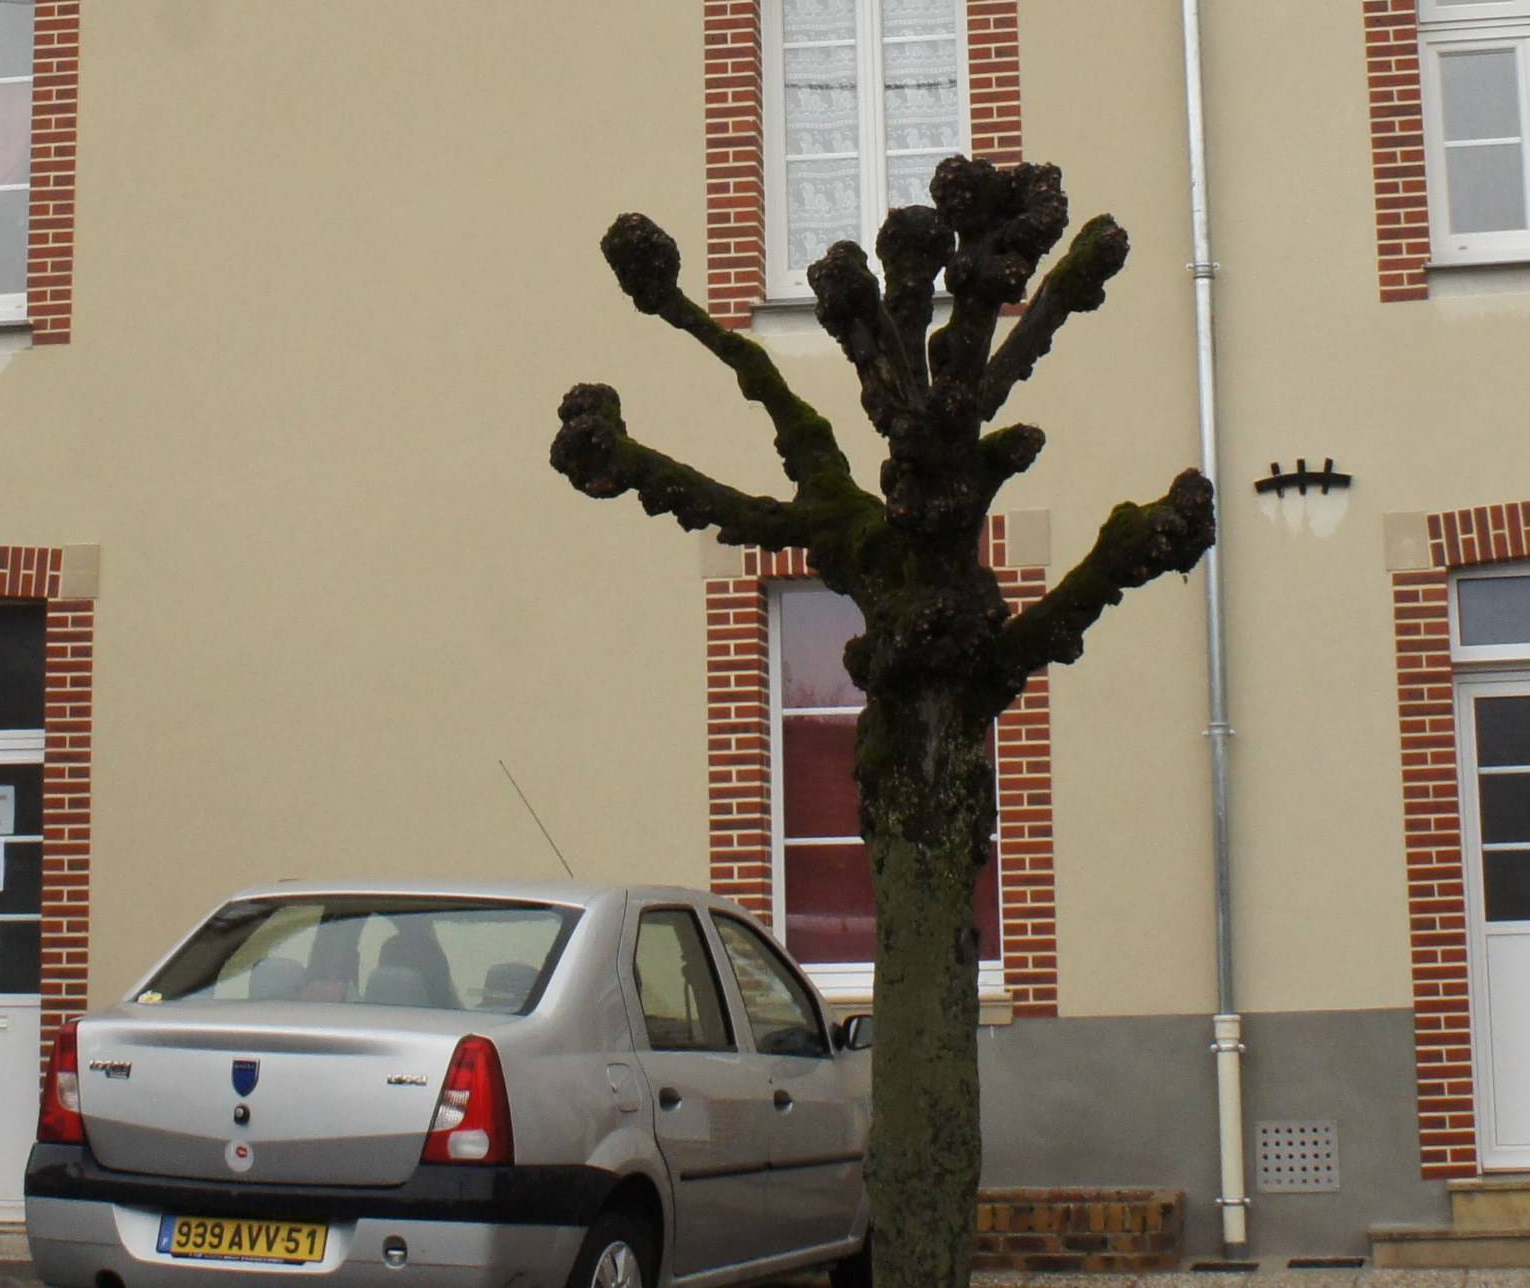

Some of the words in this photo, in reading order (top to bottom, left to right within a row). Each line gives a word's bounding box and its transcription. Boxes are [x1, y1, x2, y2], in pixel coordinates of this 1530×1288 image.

[176, 1220, 225, 1249] 939
[228, 1223, 281, 1252] AVV
[284, 1226, 318, 1255] 51
